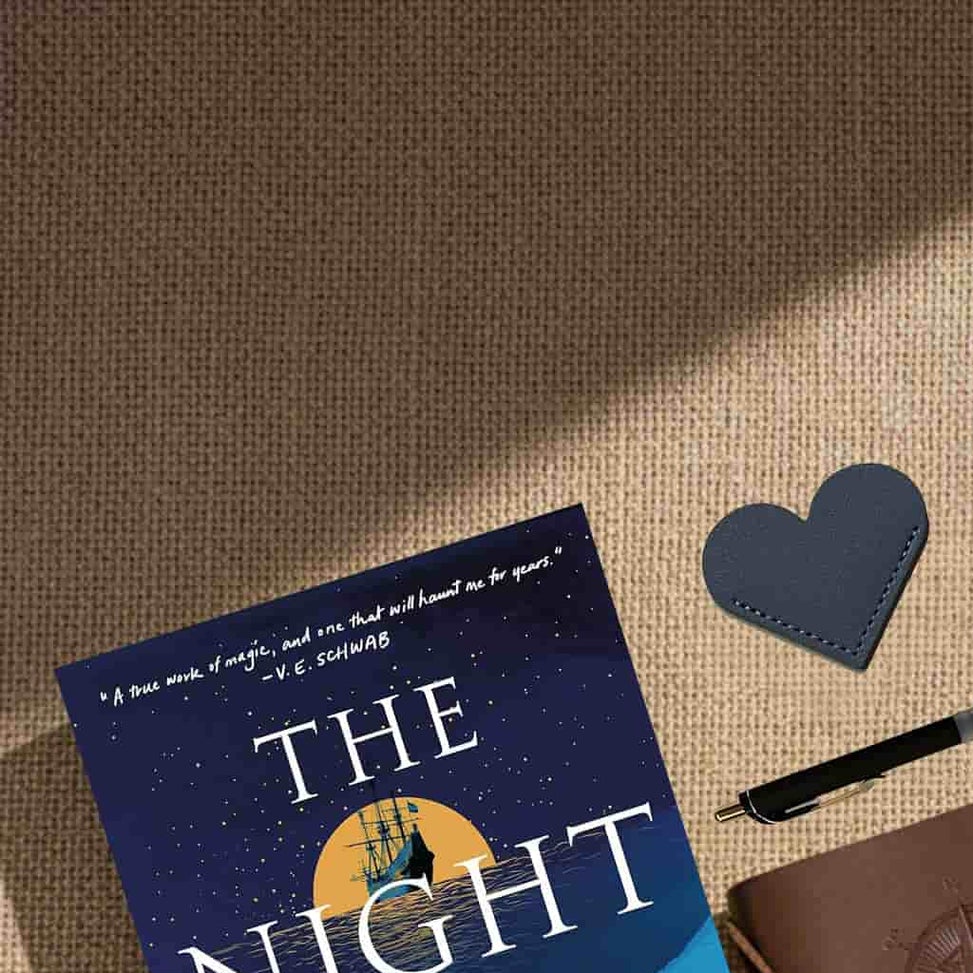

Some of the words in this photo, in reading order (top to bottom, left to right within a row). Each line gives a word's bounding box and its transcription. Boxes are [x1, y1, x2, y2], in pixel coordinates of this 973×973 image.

[129, 680, 160, 699] true
[166, 667, 204, 686] work
[208, 656, 221, 674] of
[225, 639, 277, 672] magic,
[282, 626, 311, 651] and
[317, 622, 346, 637] one
[349, 605, 385, 629] that
[389, 594, 415, 617] will
[418, 579, 462, 608] haunt
[465, 579, 486, 592] me
[488, 566, 507, 586] for
[316, 631, 391, 667] SCHWAB
[253, 676, 479, 805] THE
